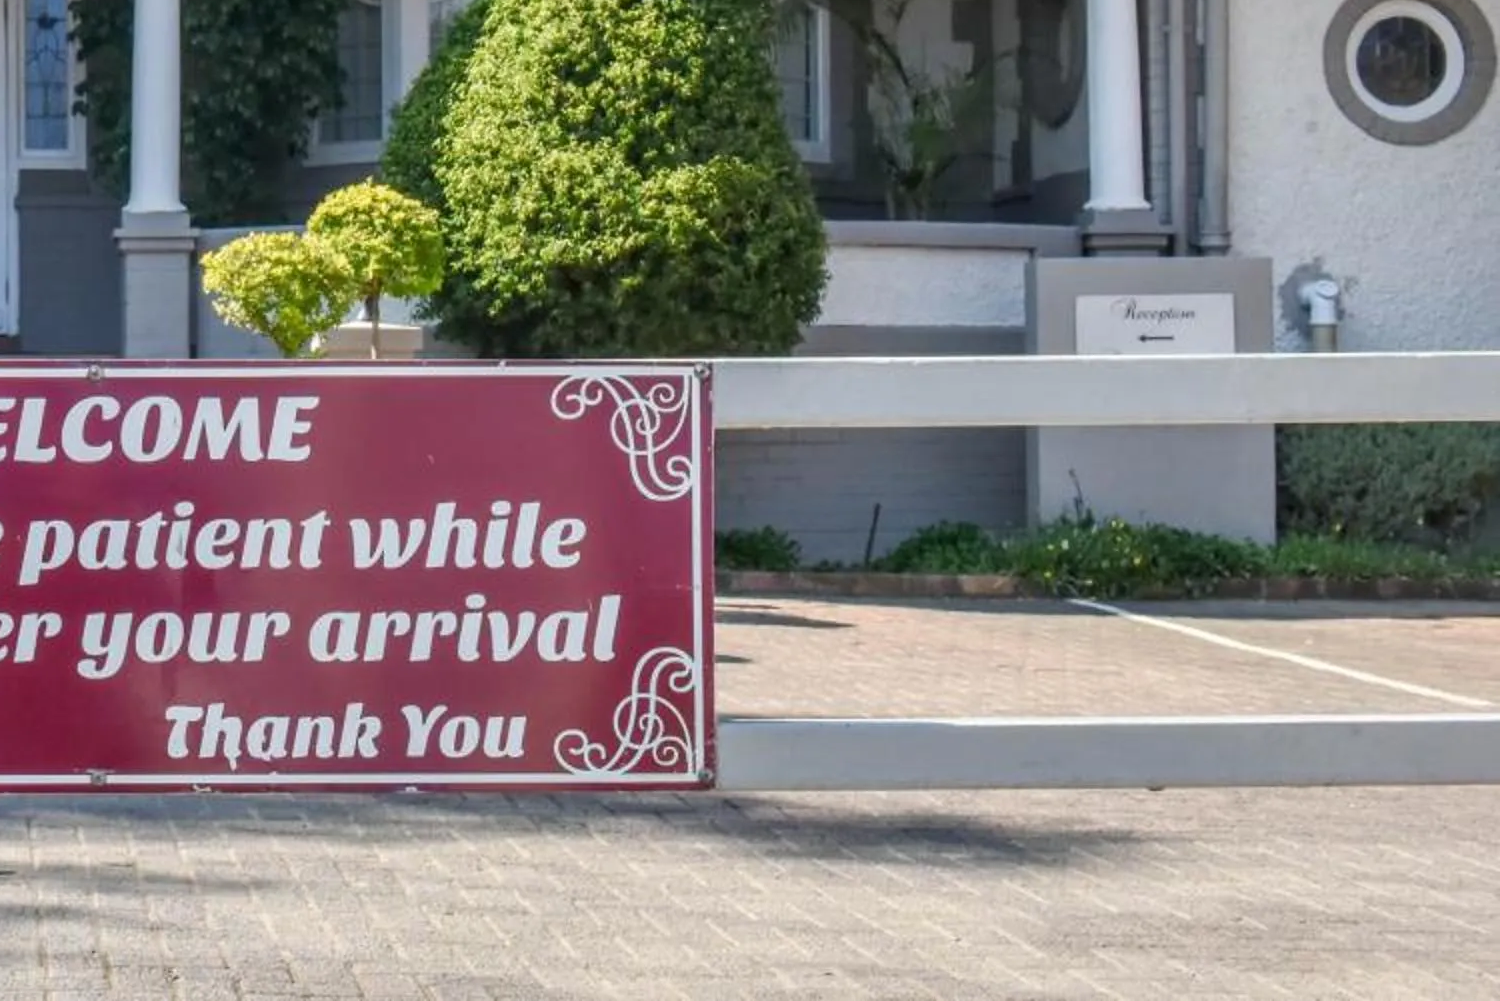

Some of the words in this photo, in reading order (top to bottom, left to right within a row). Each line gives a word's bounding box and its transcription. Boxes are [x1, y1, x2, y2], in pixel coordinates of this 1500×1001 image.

[1109, 299, 1196, 323] Reception
[19, 502, 331, 585] patient
[349, 500, 586, 569] while
[78, 612, 290, 680] your
[308, 594, 620, 663] arrival
[165, 703, 382, 767] Thank
[402, 704, 527, 759] You
